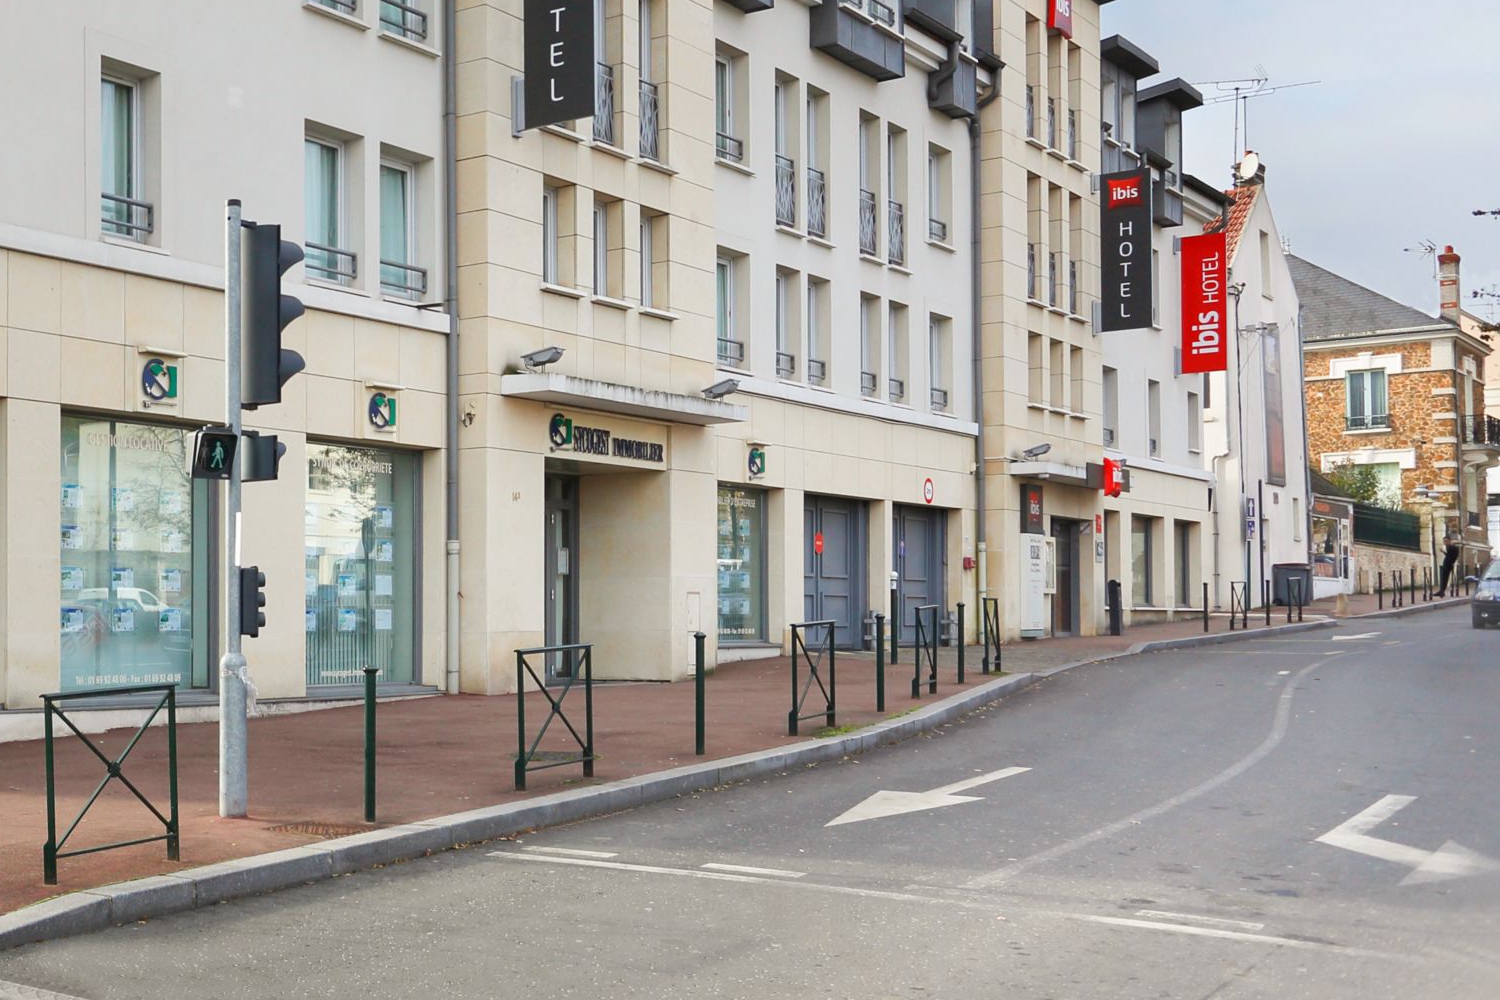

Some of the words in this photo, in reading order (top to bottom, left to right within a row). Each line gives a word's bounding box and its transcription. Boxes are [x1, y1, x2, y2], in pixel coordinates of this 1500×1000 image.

[1112, 184, 1139, 202] ibis
[1118, 220, 1134, 319] HOTEL
[1202, 251, 1220, 304] HOTEL
[1191, 309, 1220, 355] ibis
[573, 425, 610, 455] SYCOGEST
[612, 437, 664, 462] IMMOBILIER
